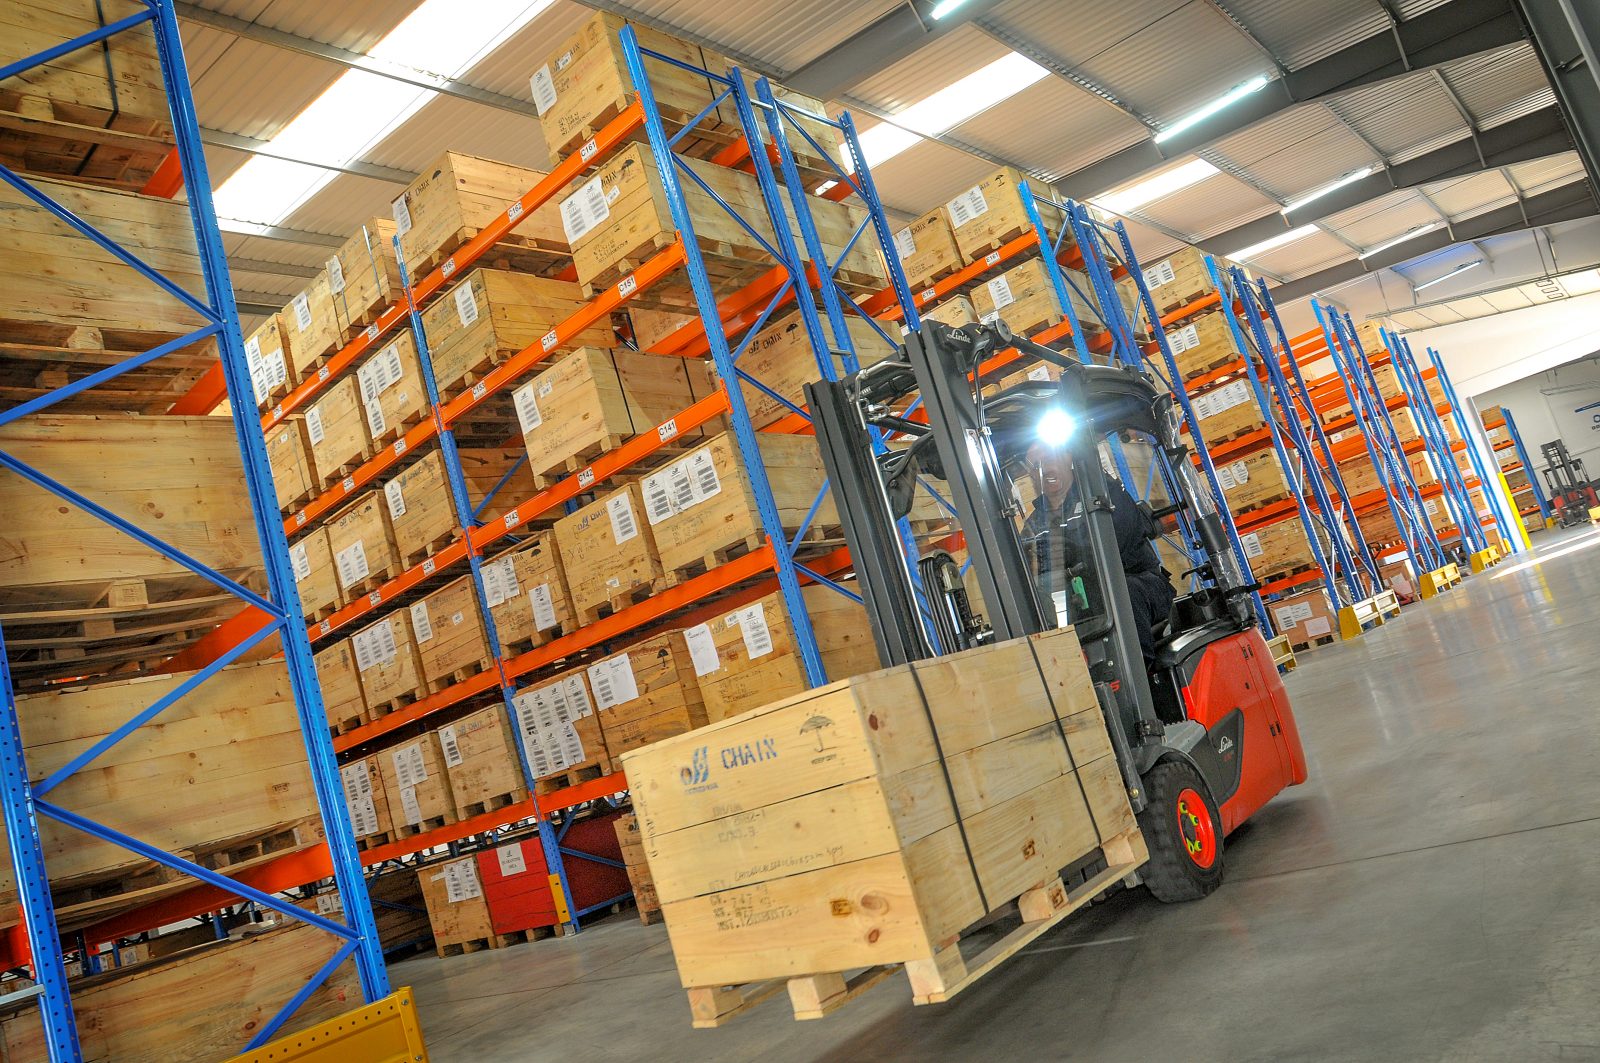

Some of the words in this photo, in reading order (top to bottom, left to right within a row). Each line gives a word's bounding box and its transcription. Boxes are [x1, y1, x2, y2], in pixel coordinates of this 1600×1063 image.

[580, 141, 596, 157] C161
[508, 202, 522, 217] C162
[619, 277, 634, 292] C151
[541, 331, 556, 346] C152
[947, 329, 971, 343] Linde
[659, 421, 675, 436] C141
[578, 469, 593, 482] C142
[504, 511, 518, 524] C143
[720, 737, 778, 770] CHAIN
